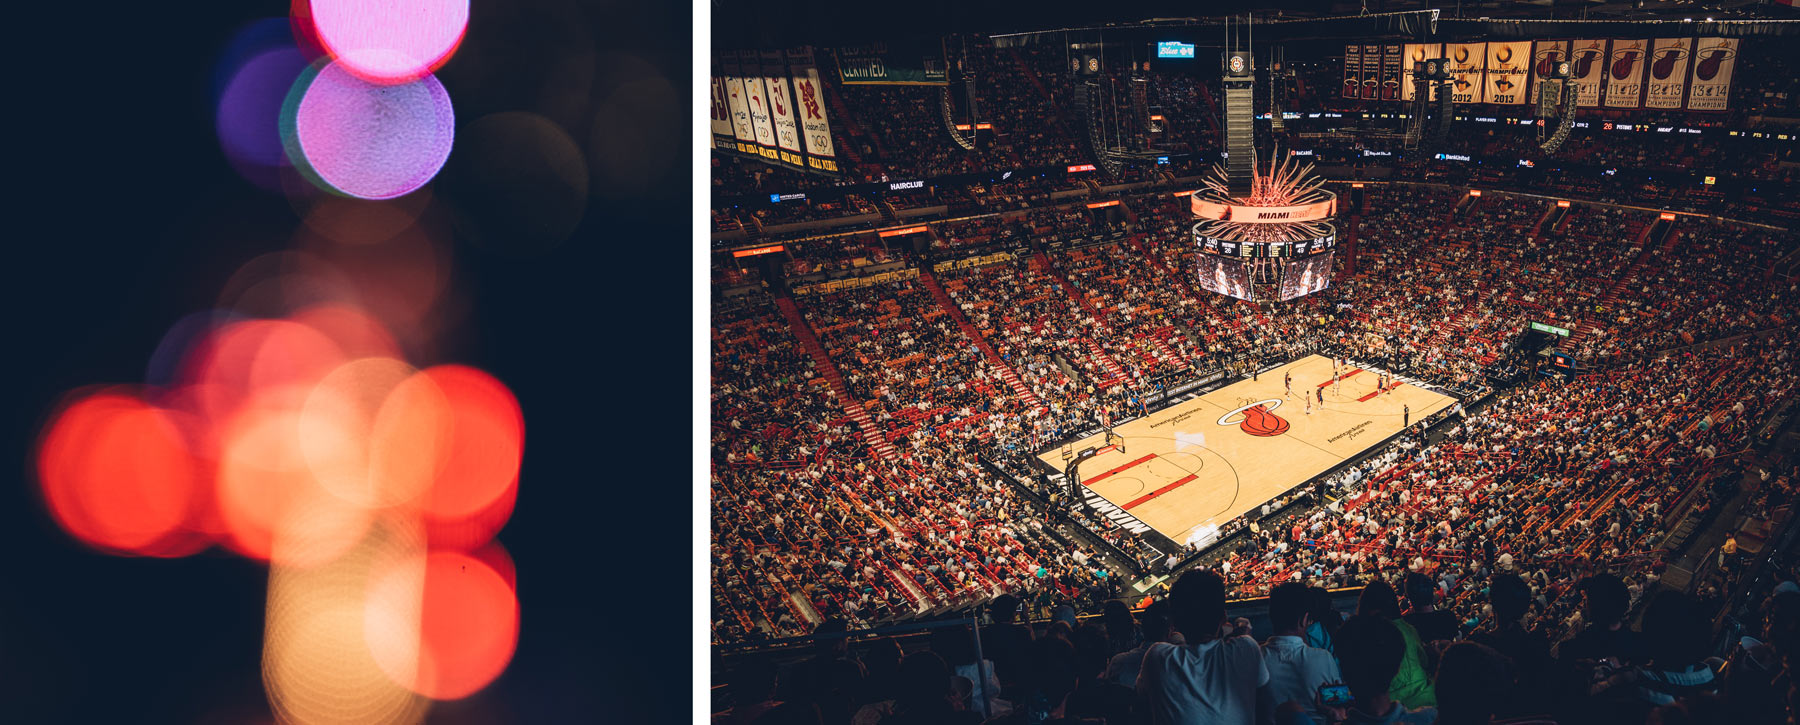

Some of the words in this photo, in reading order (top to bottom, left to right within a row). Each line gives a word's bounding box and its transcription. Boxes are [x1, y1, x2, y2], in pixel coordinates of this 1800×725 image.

[843, 58, 888, 77] CERTIFIED.
[1628, 84, 1639, 95] 12
[1650, 84, 1661, 95] 12
[1671, 84, 1682, 95] 13
[1693, 85, 1705, 96] 13
[1716, 85, 1727, 96] 14
[1452, 94, 1472, 103] 2012
[1494, 94, 1514, 104] 2013
[1603, 122, 1613, 131] 26
[1446, 154, 1470, 162] BankUnited
[890, 181, 924, 191] HAIRCLUB
[1206, 237, 1218, 245] 5:40
[1313, 236, 1324, 245] 5:40
[1085, 496, 1152, 535] MIAMI
